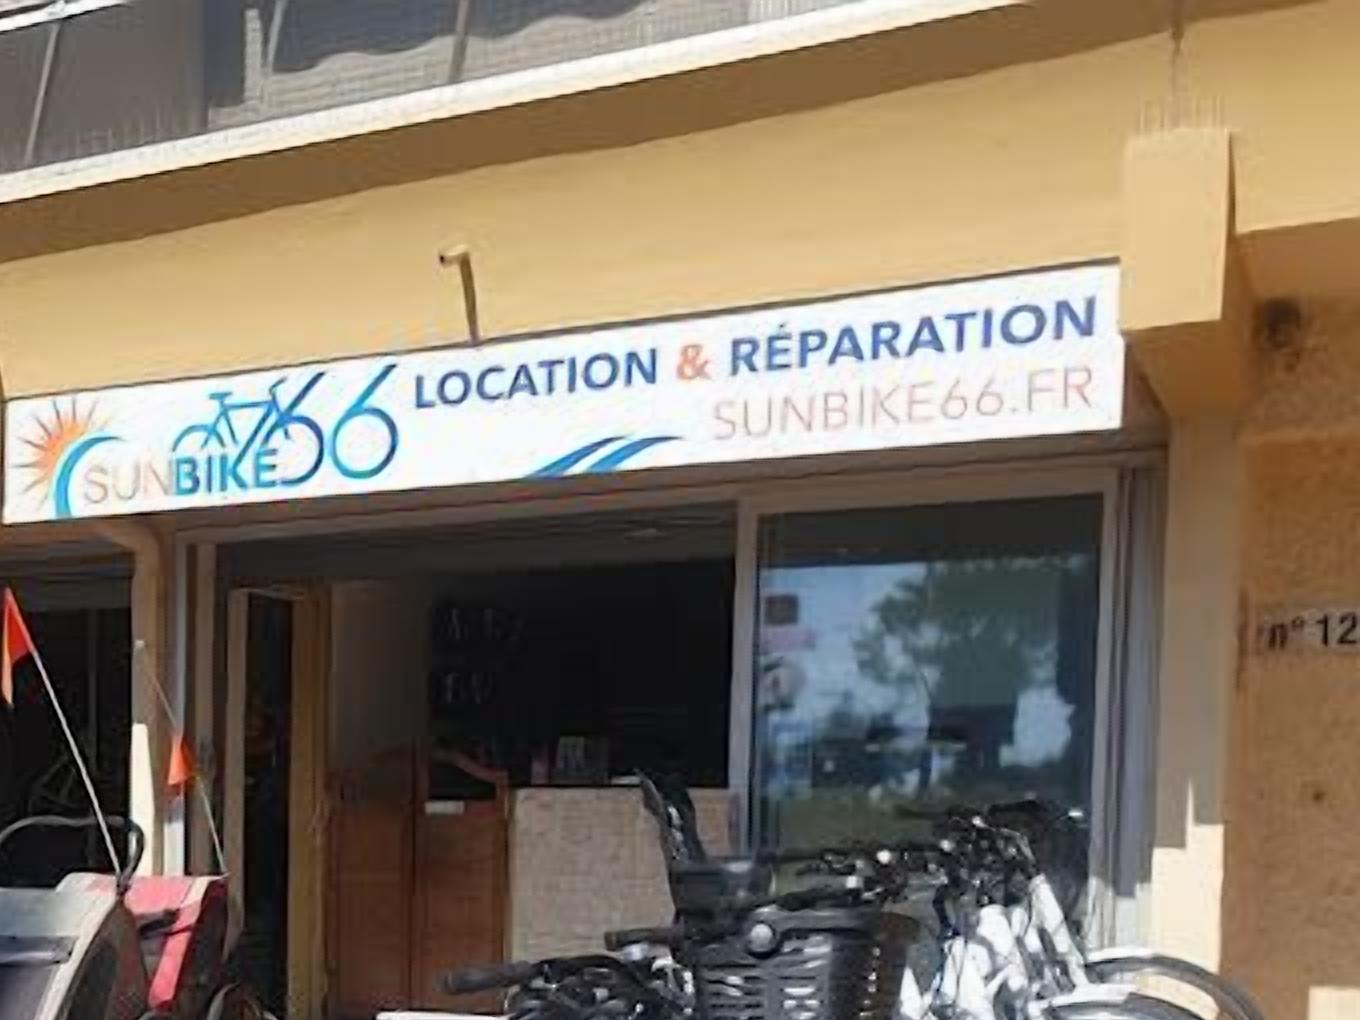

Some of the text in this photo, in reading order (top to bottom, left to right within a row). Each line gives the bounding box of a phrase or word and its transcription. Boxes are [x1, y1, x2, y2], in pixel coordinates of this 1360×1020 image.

[414, 295, 1098, 409] LOCATION & RÉPARATION
[713, 366, 1092, 440] SUNBIKE66.FR
